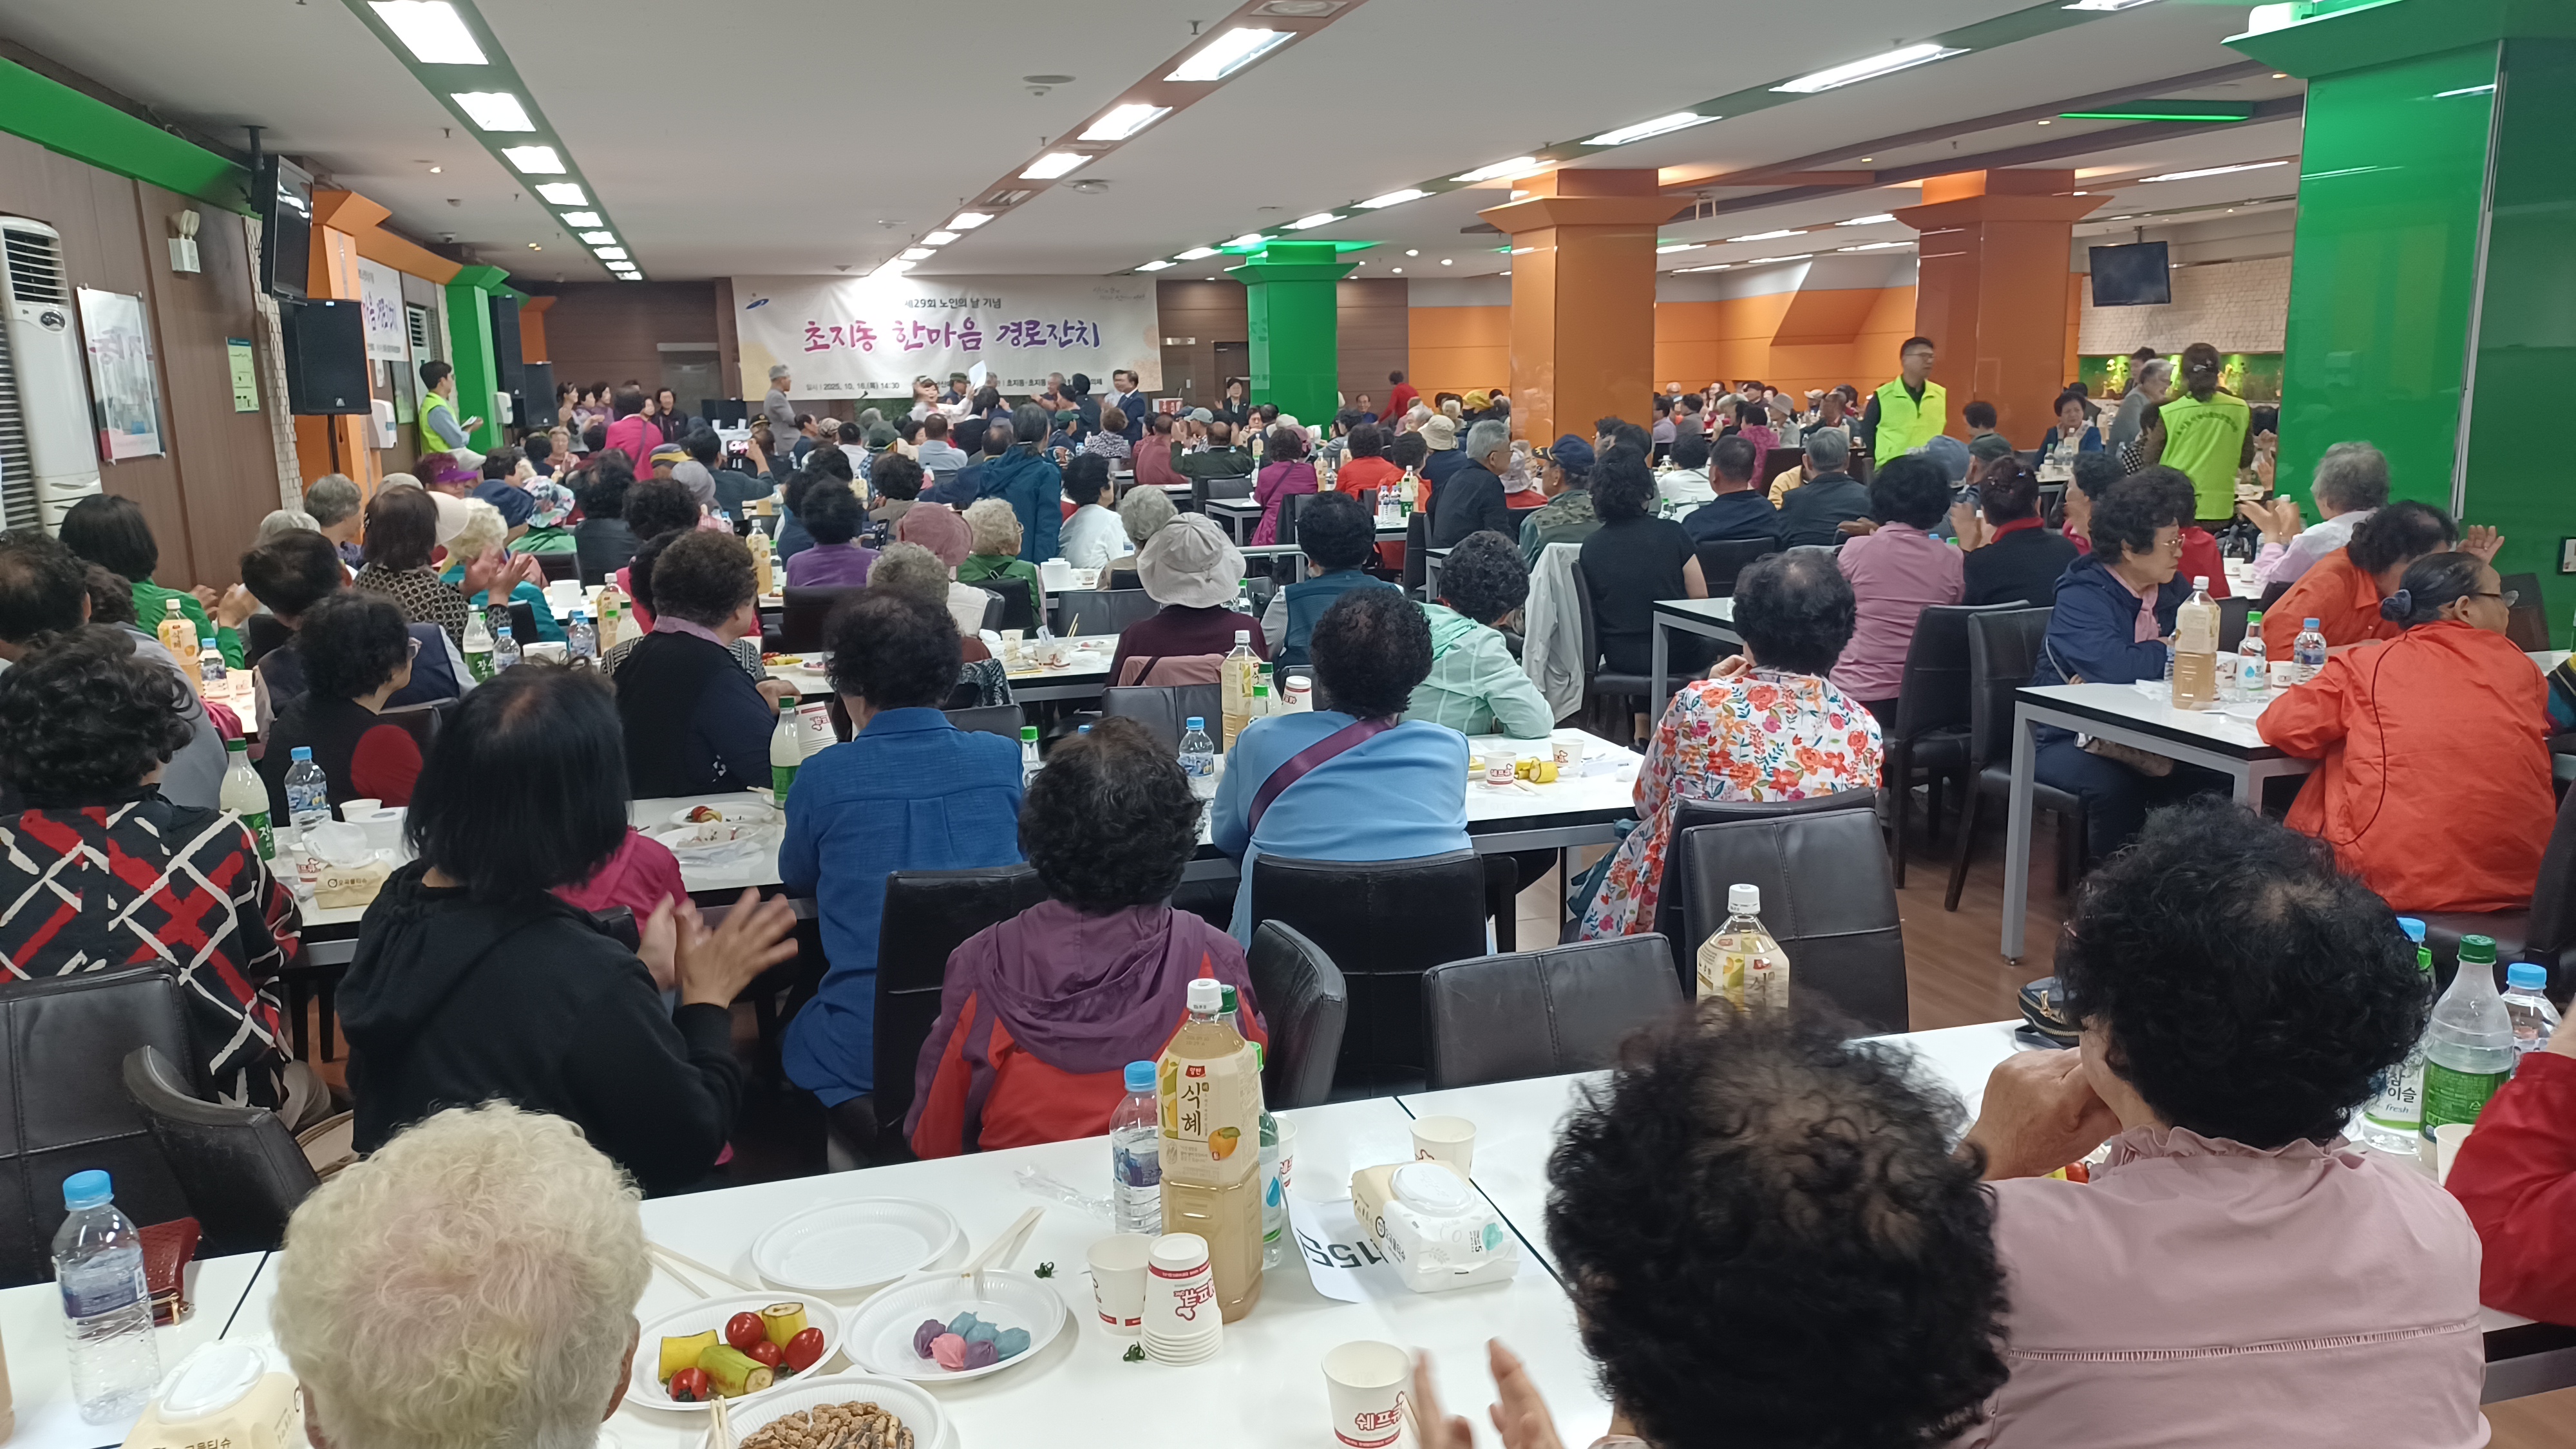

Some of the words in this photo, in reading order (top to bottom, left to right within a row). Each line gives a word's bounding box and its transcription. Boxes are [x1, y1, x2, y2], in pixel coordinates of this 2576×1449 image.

[905, 298, 936, 308] 제29회
[939, 298, 967, 309] 노인의
[971, 297, 980, 308] 날
[983, 298, 1001, 309] 기념
[804, 320, 877, 352] 초지동
[893, 316, 983, 352] 한마음
[996, 317, 1101, 349] 경로잔치
[2387, 1086, 2417, 1103] 이슬
[1180, 1082, 1201, 1136] 식혜
[2385, 1104, 2409, 1113] fresh
